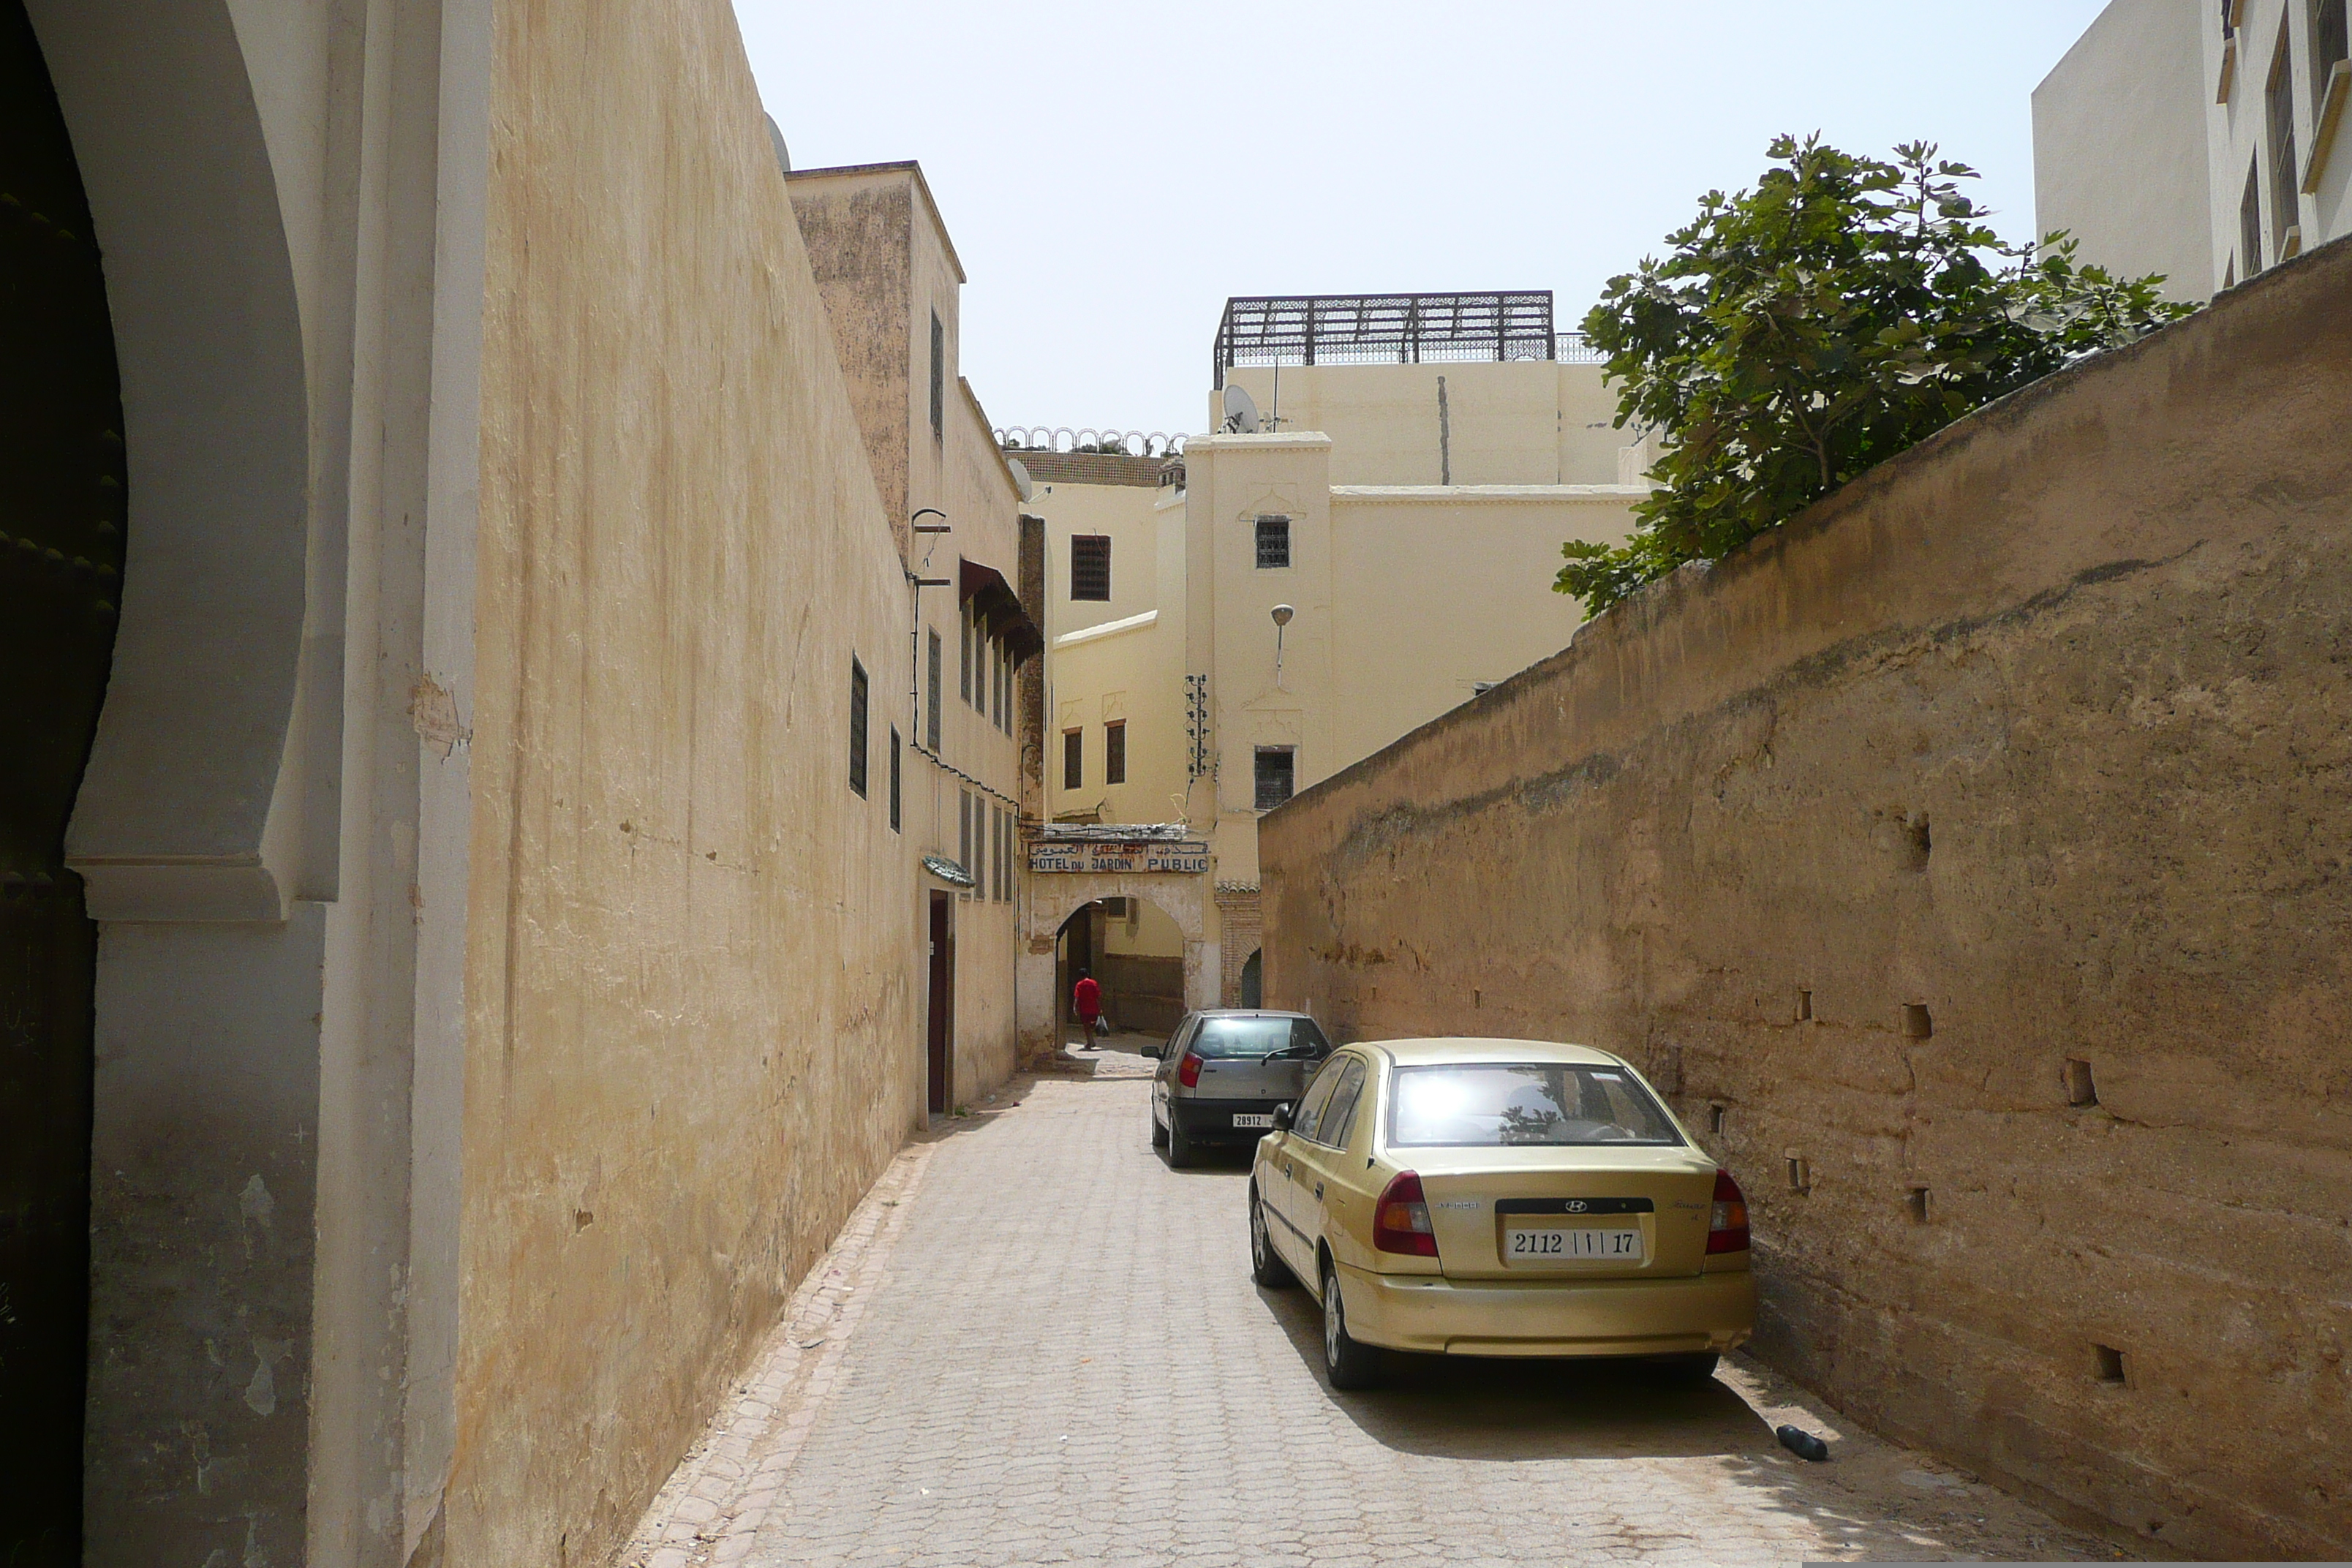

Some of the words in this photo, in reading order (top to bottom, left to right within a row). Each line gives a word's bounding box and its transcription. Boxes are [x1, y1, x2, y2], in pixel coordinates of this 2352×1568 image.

[1031, 858, 1069, 870] HOTEL
[1071, 861, 1085, 870] DU
[1091, 858, 1132, 870] JARDIN
[1147, 858, 1207, 870] PUBLIC
[1237, 1116, 1261, 1126] 28912
[1514, 1233, 1562, 1254] 2112
[1613, 1234, 1633, 1254] 17
